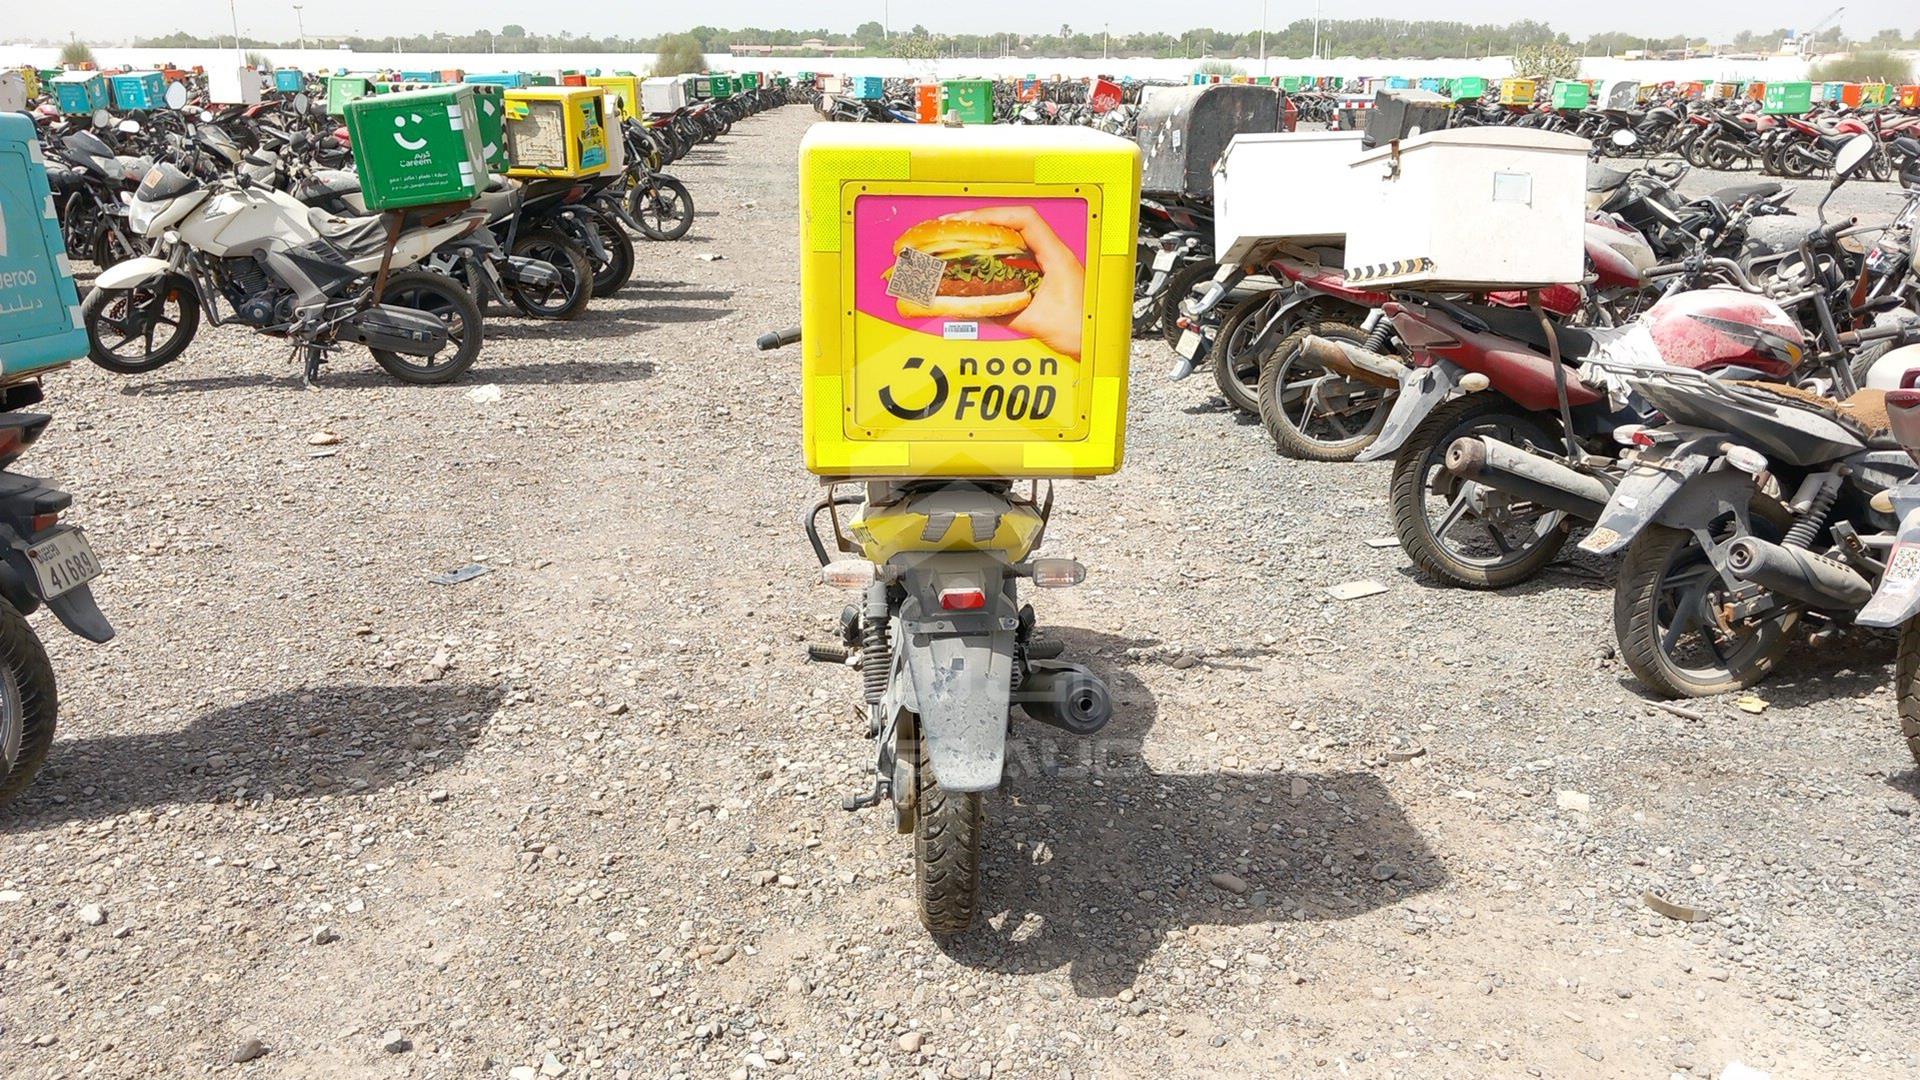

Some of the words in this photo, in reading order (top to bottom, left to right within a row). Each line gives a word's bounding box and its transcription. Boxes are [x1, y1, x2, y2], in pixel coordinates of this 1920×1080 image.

[400, 158, 432, 167] Careem
[959, 357, 1058, 376] noon
[954, 384, 1057, 421] FOOD
[50, 551, 94, 590] 41689
